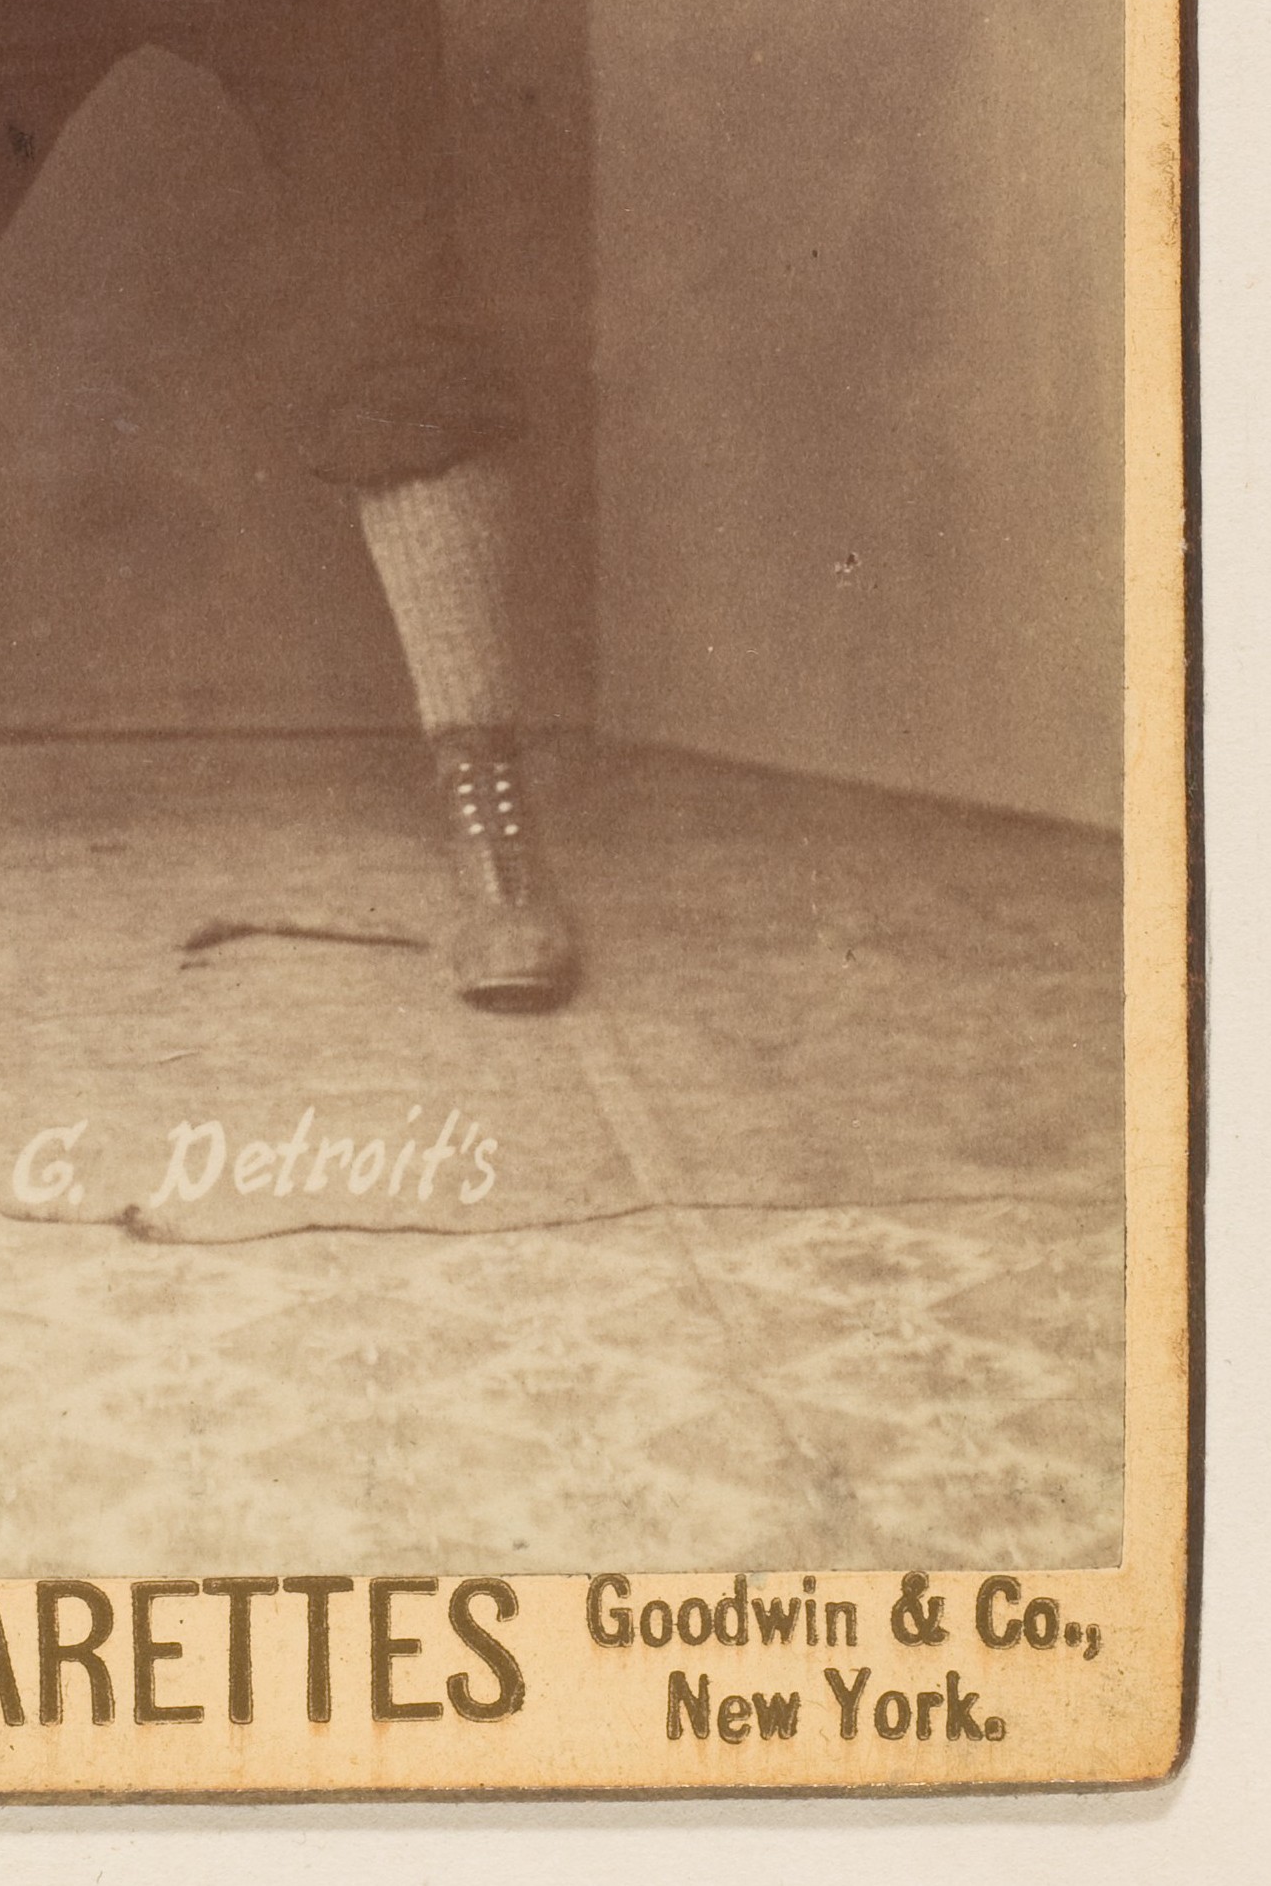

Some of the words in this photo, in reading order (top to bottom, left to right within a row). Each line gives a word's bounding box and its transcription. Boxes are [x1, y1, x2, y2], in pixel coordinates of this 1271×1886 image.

[148, 1104, 500, 1209] Detroit's
[585, 1571, 860, 1649] Goodwin
[890, 1570, 951, 1648] &
[974, 1574, 1104, 1661] Co.,
[665, 1670, 803, 1745] New
[823, 1666, 1008, 1743] York.
